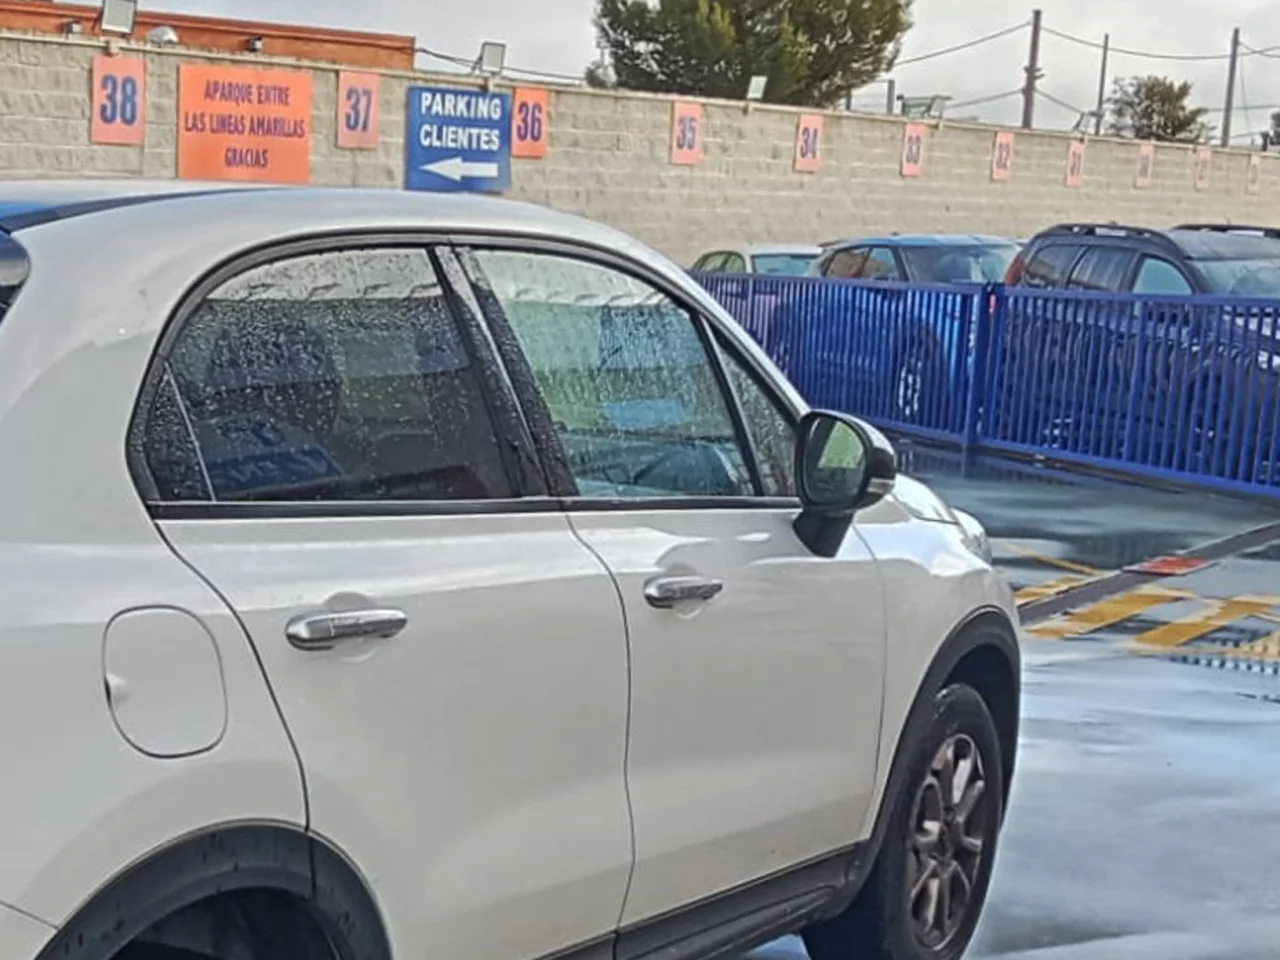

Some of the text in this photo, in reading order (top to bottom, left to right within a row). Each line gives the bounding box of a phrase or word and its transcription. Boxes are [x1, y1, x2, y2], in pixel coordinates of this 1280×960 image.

[100, 73, 137, 126] 38
[204, 79, 290, 106] APARQUE ENTRE
[421, 92, 502, 120] PARKING
[345, 87, 372, 132] 37
[516, 102, 542, 142] 36
[184, 111, 306, 139] LAS LINEAS AMARILLAS
[420, 124, 500, 151] CLIENTES
[676, 116, 696, 150] 35
[800, 127, 817, 159] 34
[225, 148, 269, 169] GRACIAS
